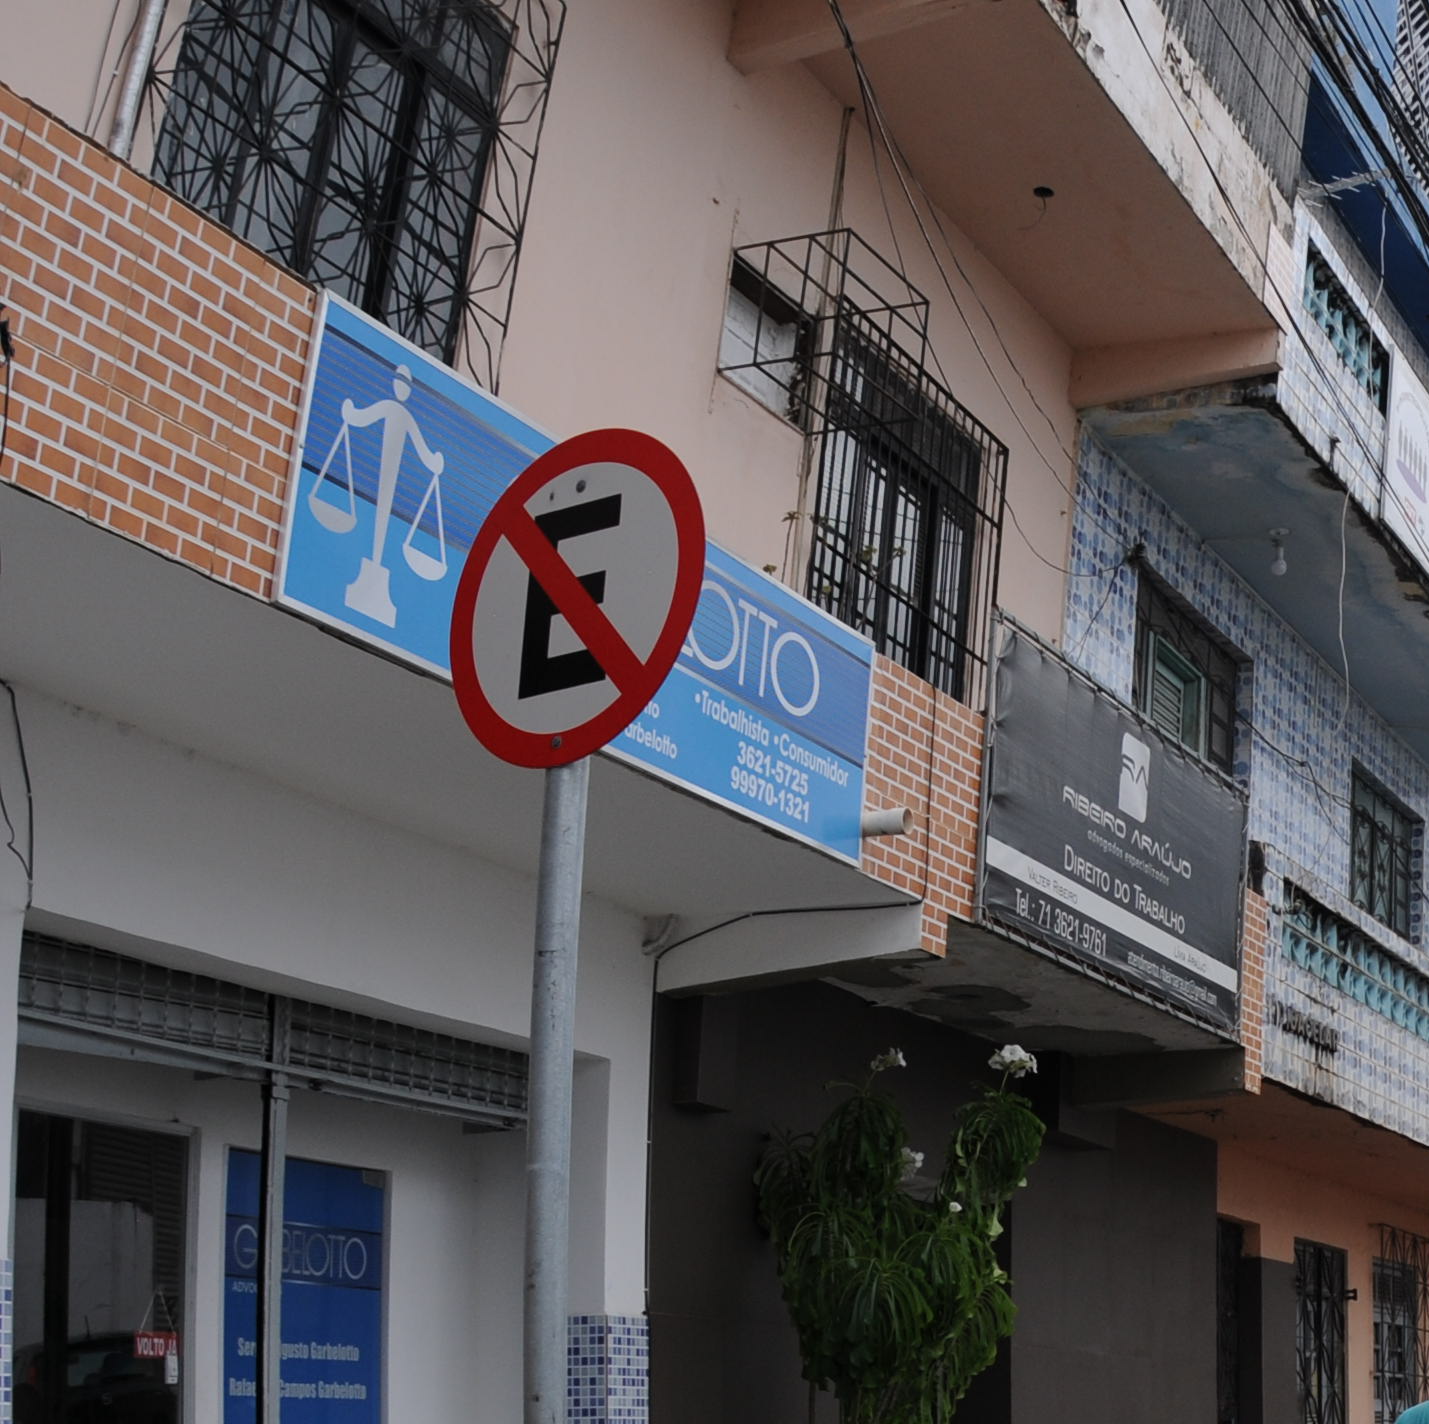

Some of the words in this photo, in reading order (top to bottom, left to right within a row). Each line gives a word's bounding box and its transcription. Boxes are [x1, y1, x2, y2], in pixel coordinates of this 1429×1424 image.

[517, 492, 622, 700] E
[682, 580, 820, 717] OTTO
[737, 741, 809, 796] 3621-5725
[780, 733, 849, 787] Consumidor
[730, 766, 810, 823] 99970-1321
[1063, 785, 1127, 839] RIBEIRO
[1131, 829, 1192, 879] ARAÚJO
[1087, 829, 1123, 858] advogados
[1015, 888, 1036, 922] Tel.:
[1039, 899, 1051, 929] 71
[1054, 908, 1107, 957] 3621-9761
[234, 1224, 367, 1279] GBELOTTO
[137, 1336, 165, 1356] VOLTO
